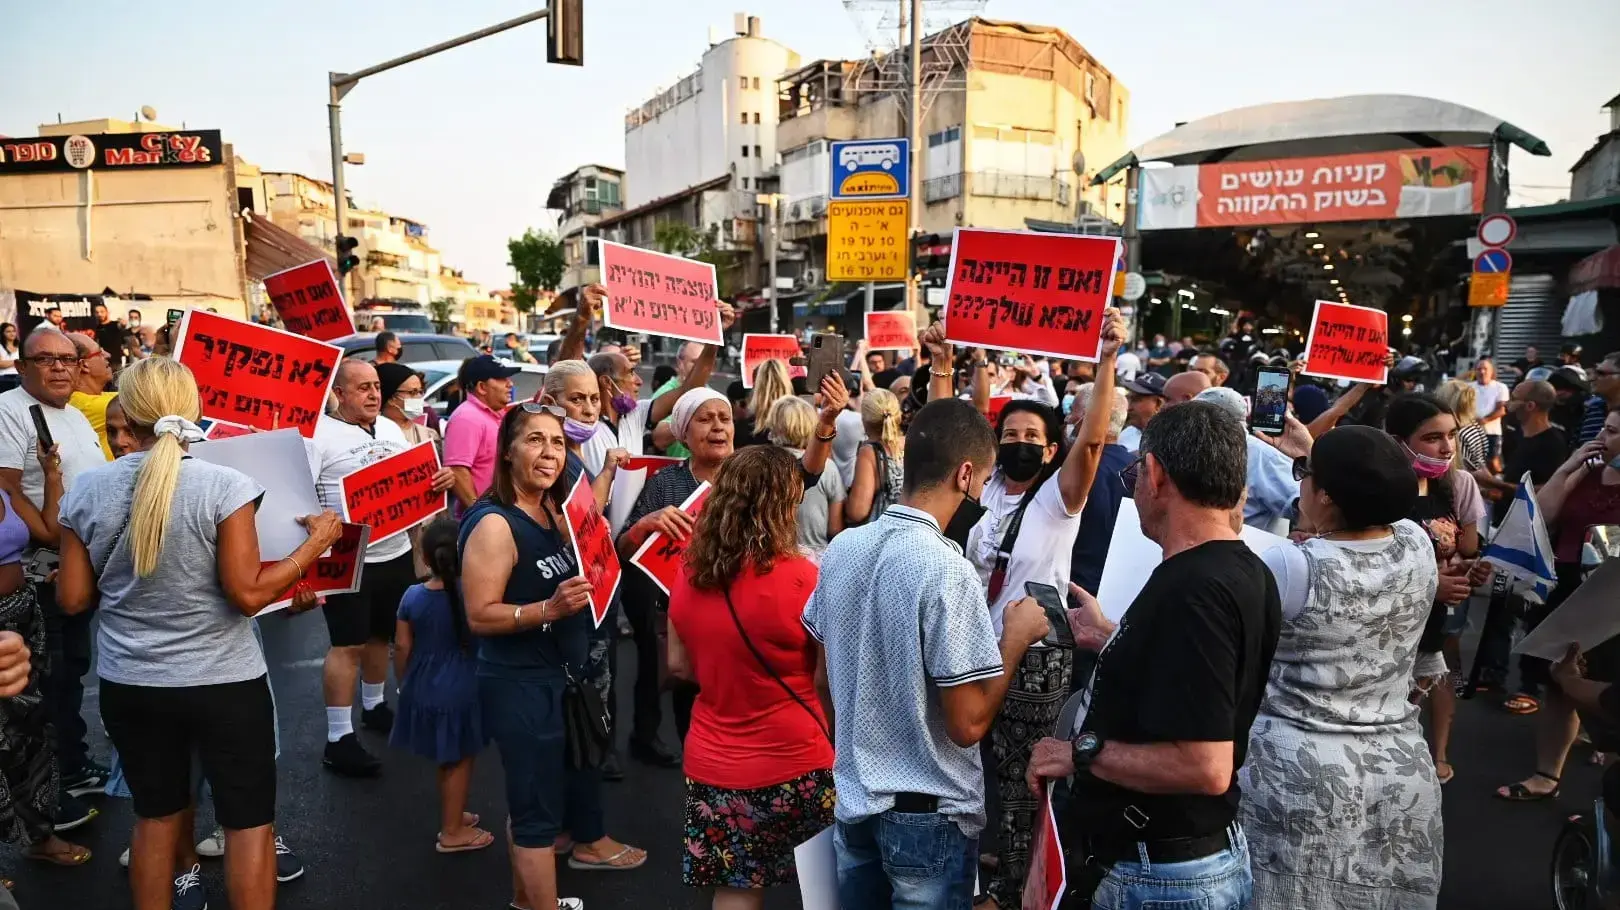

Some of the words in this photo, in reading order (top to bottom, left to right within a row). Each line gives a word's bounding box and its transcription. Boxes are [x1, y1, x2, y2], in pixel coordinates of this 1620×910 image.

[141, 133, 200, 151] City
[105, 146, 210, 165] Market
[1220, 168, 1304, 192] עושים
[1311, 162, 1387, 188] קניות
[832, 206, 885, 217] אופנועים
[889, 206, 904, 216] גם
[1217, 194, 1308, 216] התקווה
[1312, 190, 1387, 213] בשוק
[841, 237, 855, 246] 19
[861, 236, 875, 247] עד
[880, 237, 895, 246] 10
[608, 263, 661, 290] יהודית
[840, 266, 855, 275] 16
[860, 266, 874, 276] עד
[880, 266, 894, 276] 10
[959, 258, 1028, 288] הייתה
[1032, 264, 1053, 290] זו
[1058, 266, 1104, 294] ואם
[664, 275, 714, 302] עוצמה
[649, 301, 688, 324] דרום
[692, 308, 714, 330] עם
[952, 293, 1035, 330] שלך???
[1038, 304, 1093, 332] אמא
[1317, 320, 1355, 341] הייתה
[193, 333, 285, 380] נפקיר
[288, 358, 331, 388] לא
[286, 405, 317, 425] את
[350, 476, 395, 510] יהודית
[386, 493, 421, 521] דרום
